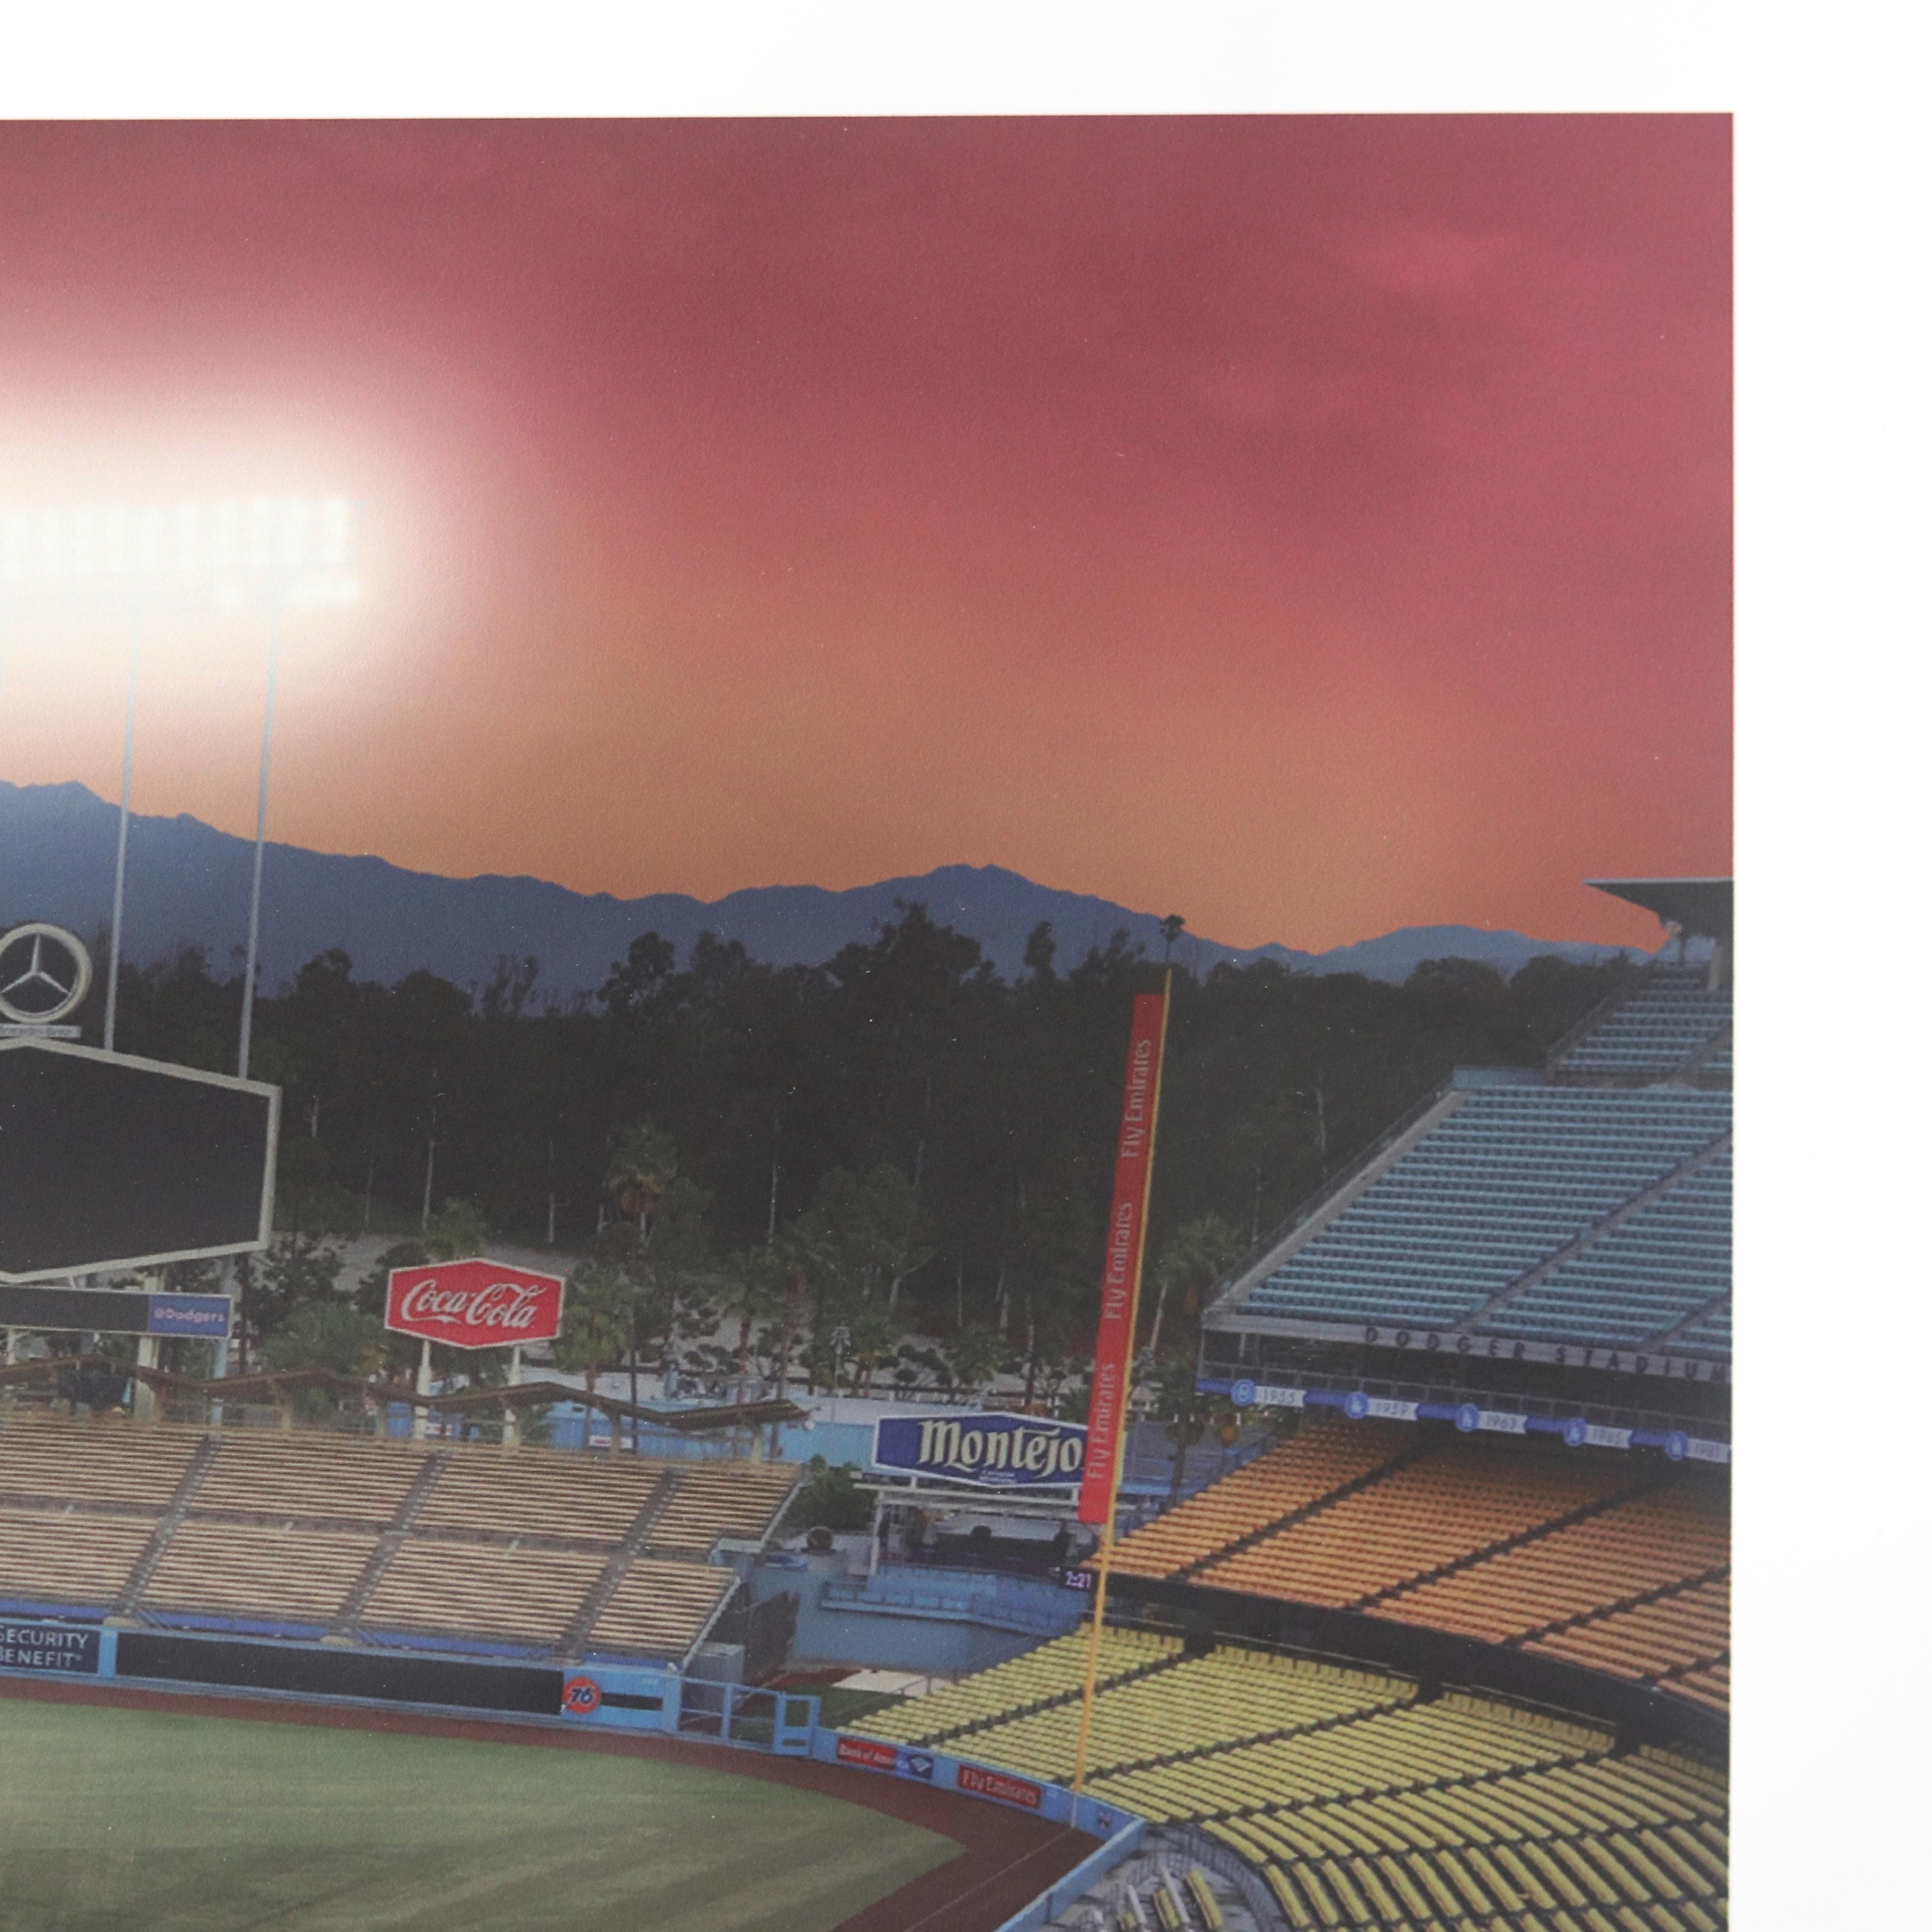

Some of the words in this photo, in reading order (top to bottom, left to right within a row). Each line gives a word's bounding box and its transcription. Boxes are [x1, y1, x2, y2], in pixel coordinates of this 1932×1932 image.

[1124, 1039, 1151, 1122] Emirates
[1121, 1126, 1147, 1157] Fly
[1108, 1202, 1133, 1283] Emirates
[155, 1307, 225, 1324] @Dodgers
[401, 1279, 547, 1328] Coca-Cola
[1104, 1288, 1126, 1319] Fly
[1365, 1326, 1525, 1358] DODGER
[1555, 1345, 1726, 1383] STADIUM
[1091, 1364, 1115, 1444] Emirates
[917, 1419, 1084, 1479] Montejo
[1088, 1448, 1110, 1478] Fly
[571, 1687, 593, 1704] 76
[962, 1769, 984, 1790] Fly
[986, 1775, 1037, 1806] Emirates
